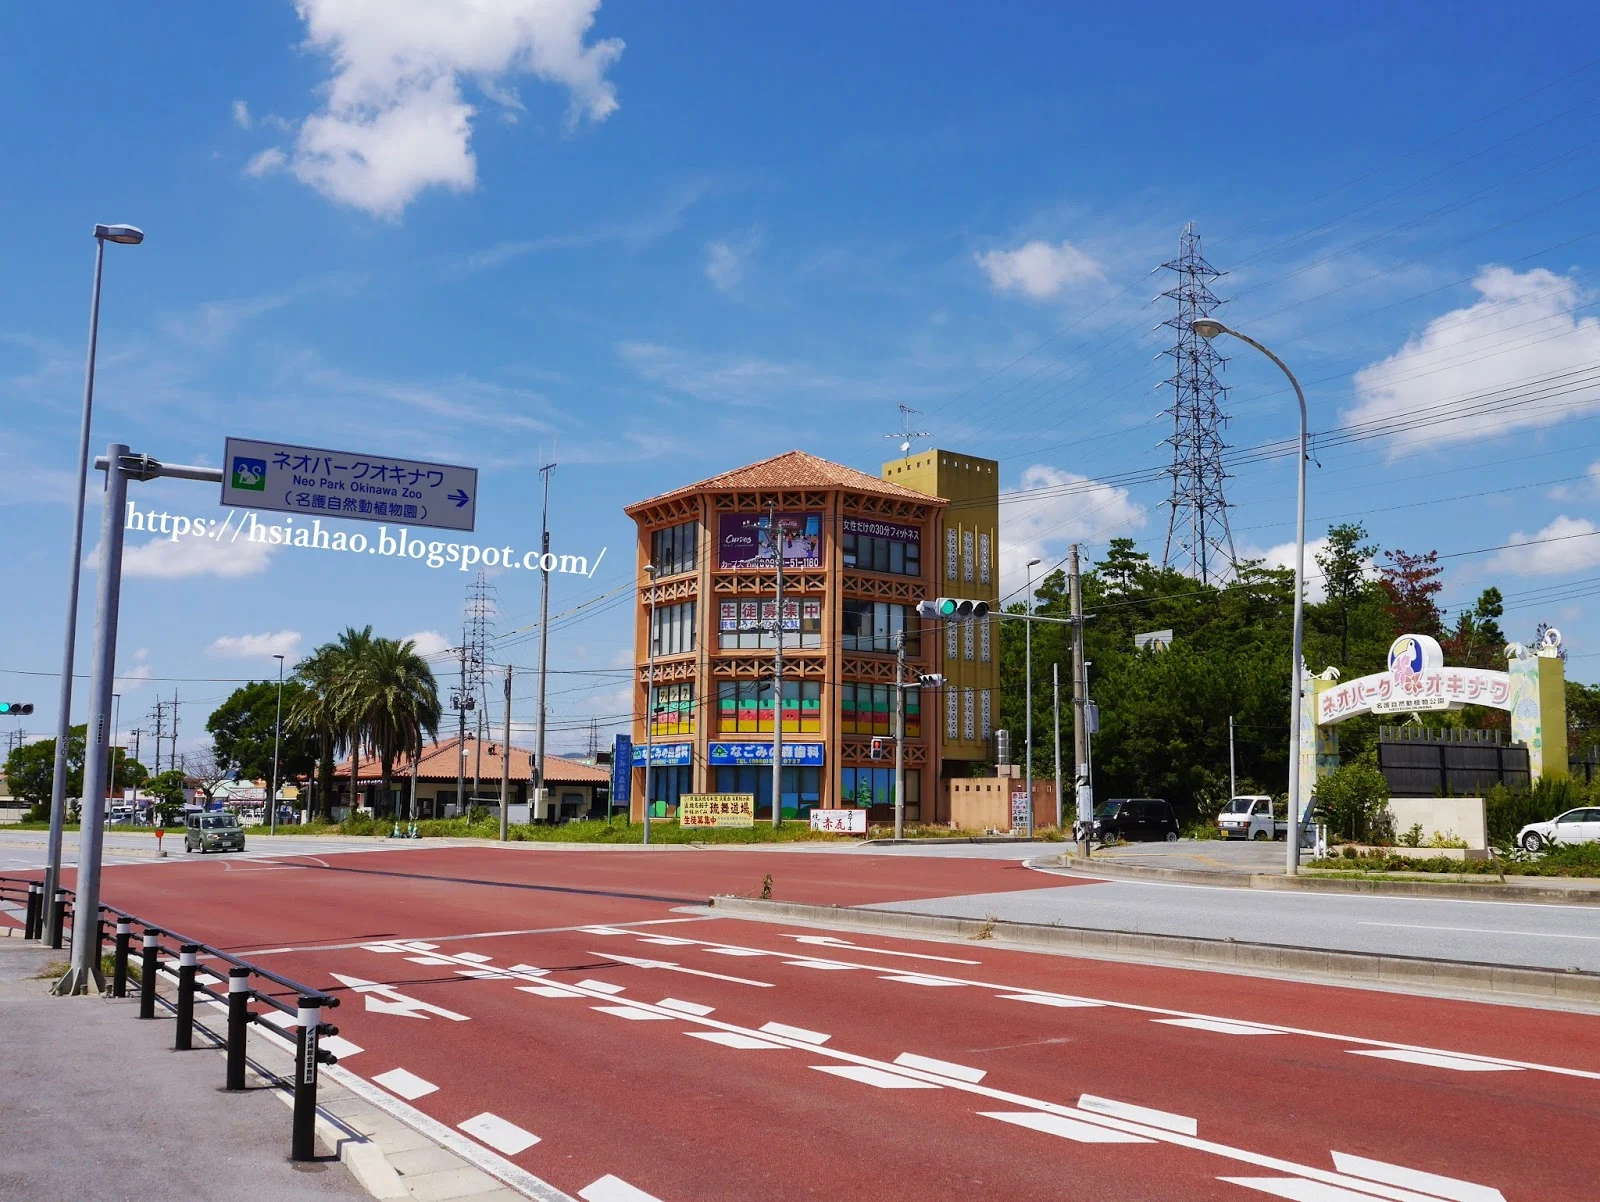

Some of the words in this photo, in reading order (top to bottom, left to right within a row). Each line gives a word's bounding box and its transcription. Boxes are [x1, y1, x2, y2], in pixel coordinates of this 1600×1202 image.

[272, 451, 444, 488] ネオパークオキナワ
[293, 476, 315, 487] Neo
[320, 478, 345, 490] Park
[350, 482, 397, 497] Okinawa
[402, 487, 422, 500] Zoo
[843, 520, 920, 540] 女性だけの30分フィットネス
[725, 534, 752, 544] Curves
[721, 603, 819, 618] 生徒募集中
[684, 816, 717, 825] 生徒募集中
[822, 817, 845, 830] 赤瓦
